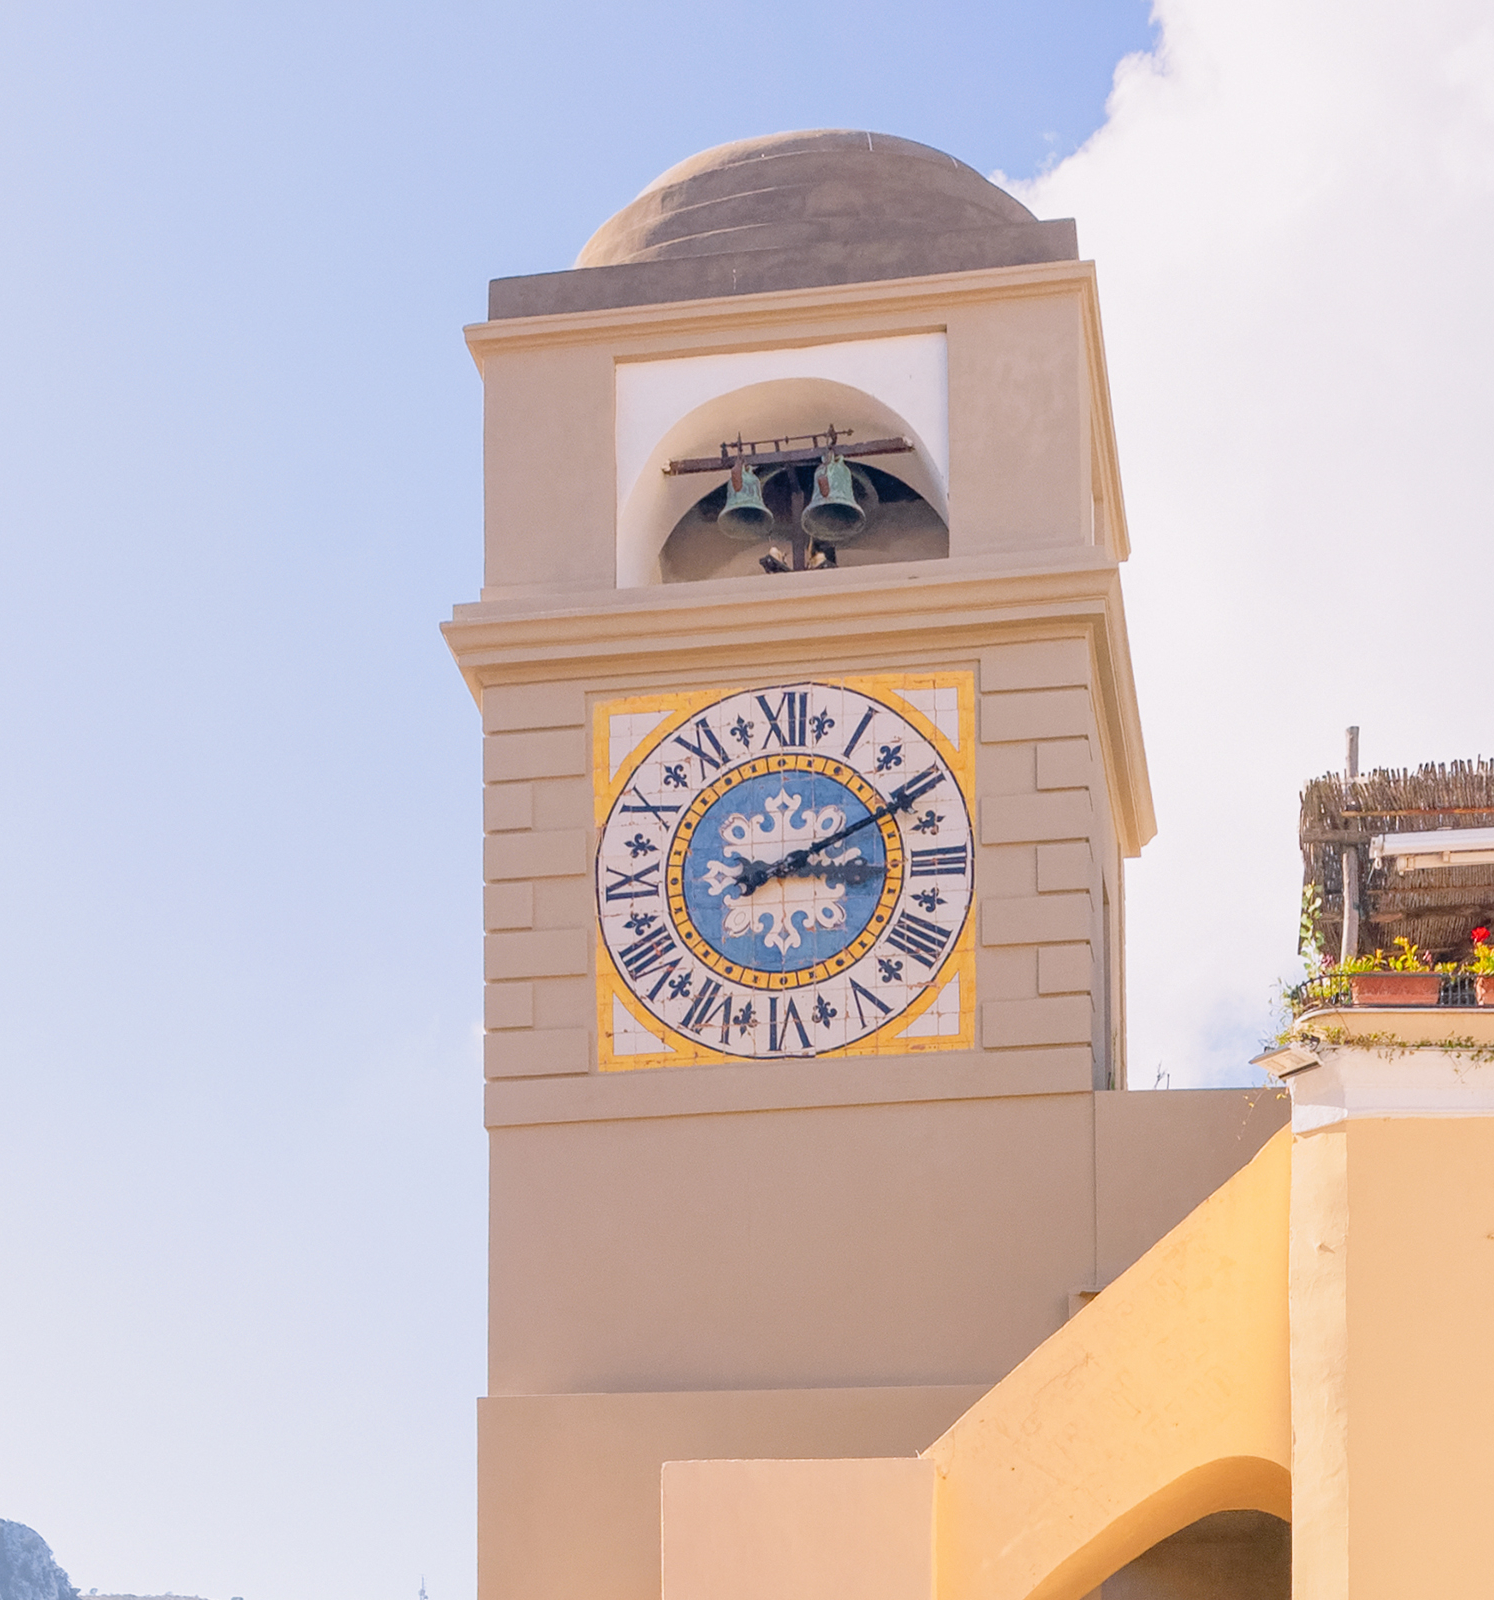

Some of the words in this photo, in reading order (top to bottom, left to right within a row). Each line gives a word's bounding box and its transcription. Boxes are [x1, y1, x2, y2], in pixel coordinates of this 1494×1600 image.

[756, 692, 808, 749] XII
[842, 706, 880, 759] I
[673, 717, 733, 781] XI
[619, 787, 684, 831] X
[606, 861, 660, 903] IX
[910, 843, 967, 877] III
[618, 925, 683, 1003] VIII
[885, 910, 953, 969] IIII
[680, 975, 733, 1046] VII
[767, 996, 814, 1052] VI
[849, 977, 894, 1029] V
